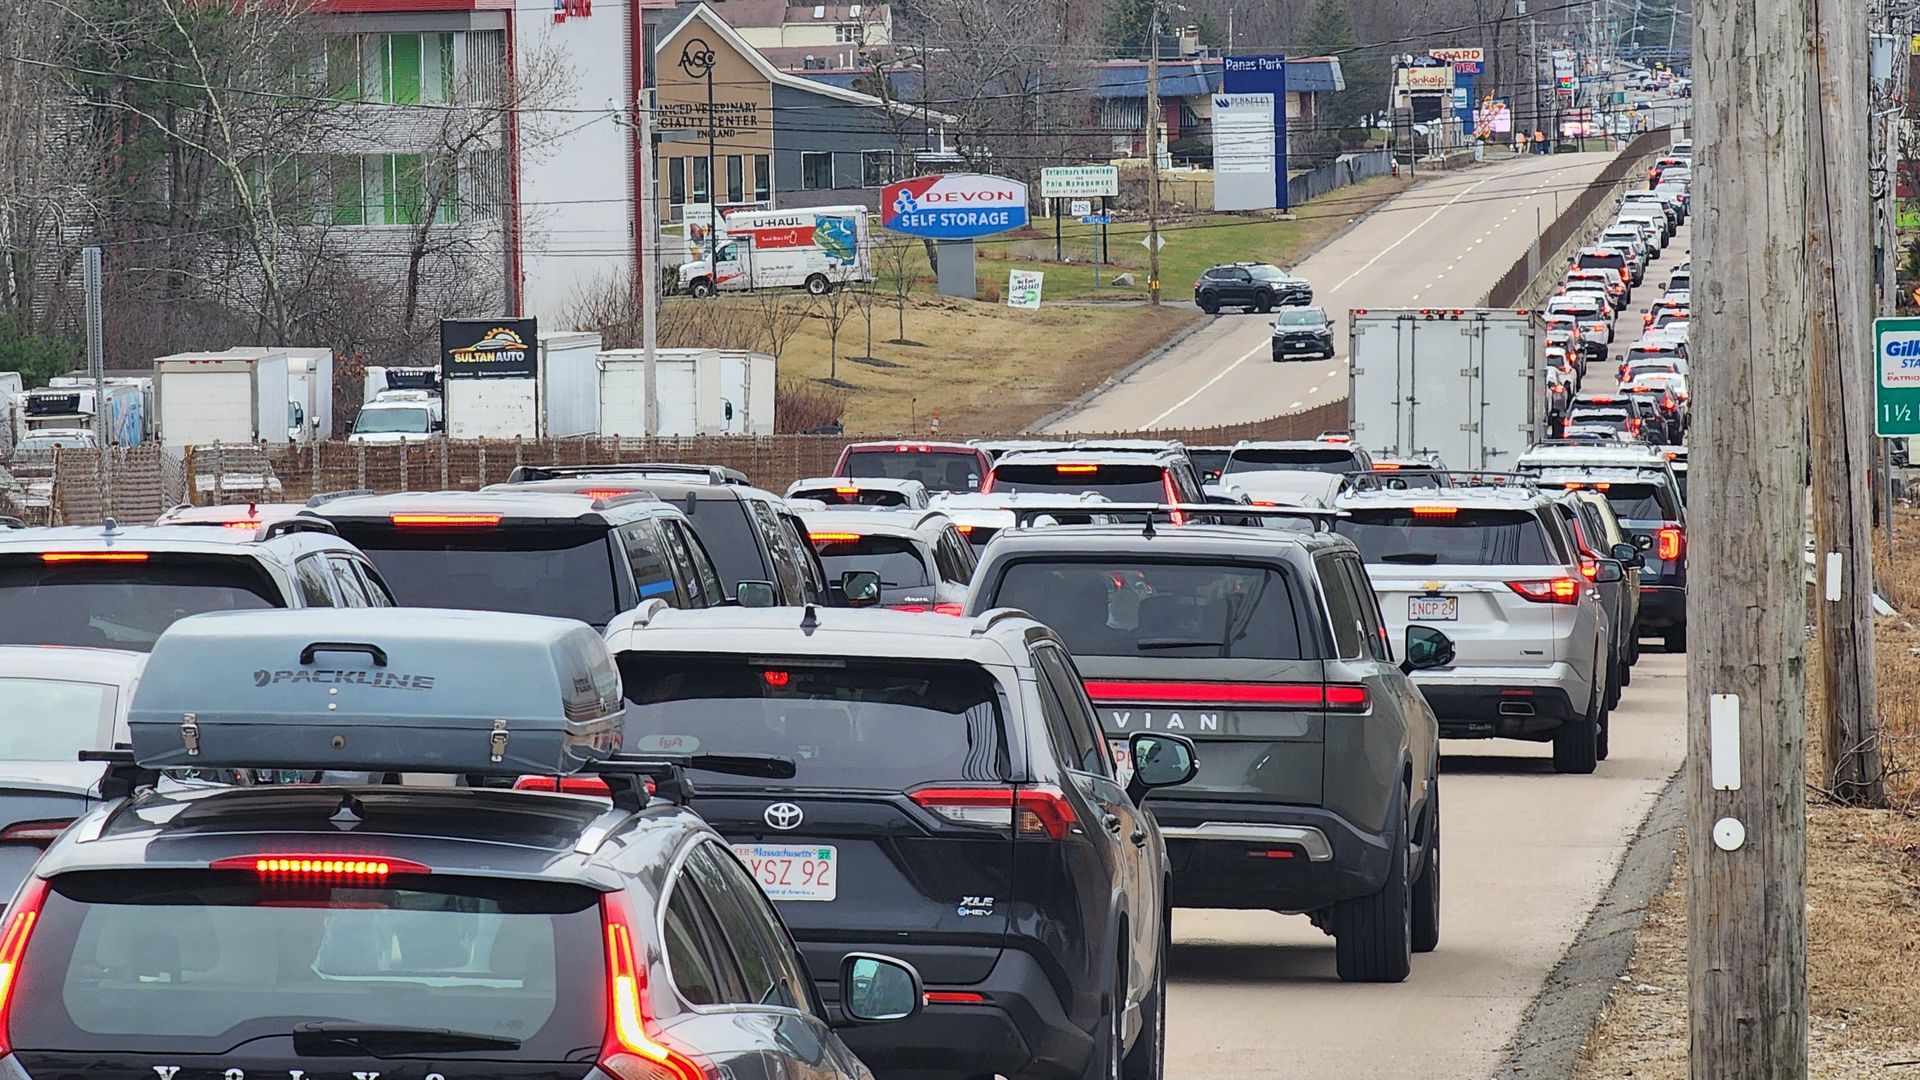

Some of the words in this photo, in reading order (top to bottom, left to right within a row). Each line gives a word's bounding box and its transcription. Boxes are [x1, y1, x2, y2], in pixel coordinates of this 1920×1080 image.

[1259, 58, 1282, 70] Park
[1455, 63, 1480, 73] TEL
[1409, 75, 1444, 87] ankalp
[657, 104, 692, 117] ANCED
[694, 102, 757, 115] VEERINARY
[656, 117, 704, 128] CIALTY
[926, 191, 1013, 202] DEVON
[753, 217, 803, 228] U-HAUL
[902, 213, 936, 227] SELF
[940, 212, 1009, 226] STORAGE
[1886, 340, 1920, 357] Gill
[1411, 602, 1438, 615] 1NCP
[1442, 602, 1455, 615] 29
[272, 670, 435, 690] PACKLINE
[1113, 712, 1218, 731] VIAN
[752, 848, 812, 857] Massachusetts
[748, 859, 792, 885] YSZ
[802, 860, 830, 886] 92
[960, 896, 994, 906] XLE
